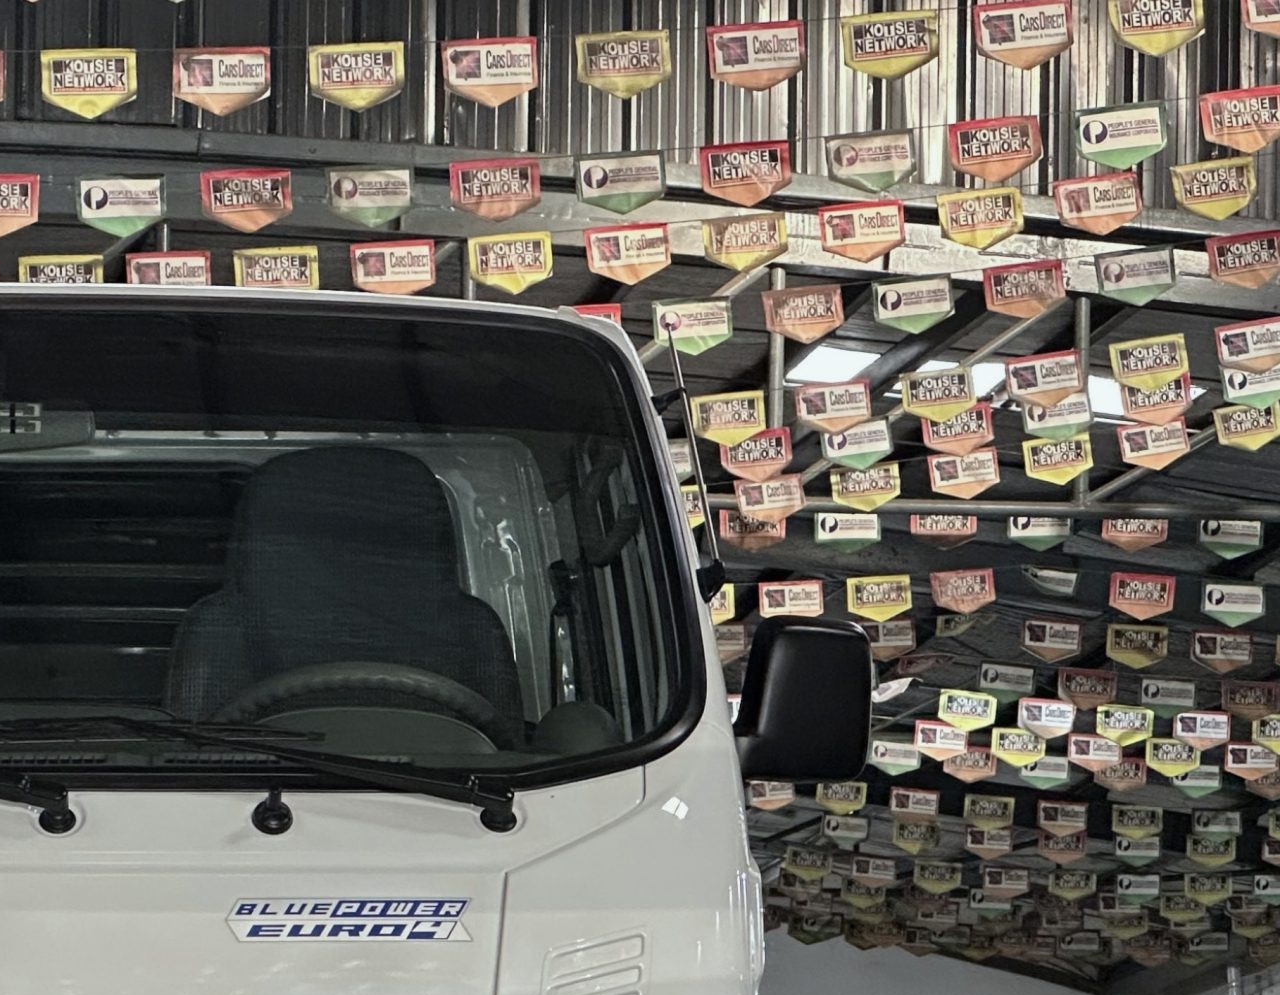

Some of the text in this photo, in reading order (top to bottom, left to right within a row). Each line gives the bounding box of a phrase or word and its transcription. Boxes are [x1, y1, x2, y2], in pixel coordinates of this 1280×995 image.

[1121, 7, 1192, 27] NETWORK
[864, 22, 915, 37] KOTSE
[598, 40, 649, 54] KOTSE
[855, 37, 926, 52] NETWORK
[63, 59, 114, 73] KOTSE
[332, 54, 383, 67] KOTSE
[589, 54, 660, 68] NETWORK
[53, 73, 124, 87] NETWORK
[322, 66, 393, 82] NETWORK
[1134, 119, 1158, 127] GENERAL
[1213, 110, 1279, 128] NETWORK
[970, 127, 1018, 141] KOTSE
[961, 140, 1030, 156] NETWORK
[721, 150, 769, 164] KOTSE
[472, 169, 518, 182] KOTSE
[1192, 167, 1235, 183] KOTSE
[222, 179, 271, 192] KOTSE
[463, 182, 529, 196] NETWORK
[1184, 181, 1246, 197] NETWORK
[214, 192, 281, 206] NETWORK
[959, 197, 1002, 212] KOTSE
[951, 209, 1012, 225] NETWORK
[489, 242, 533, 255] KOTSE
[1227, 240, 1267, 255] KOTSE
[254, 256, 298, 268] KOTSE
[481, 253, 542, 267] NETWORK
[1220, 252, 1277, 268] NETWORK
[39, 265, 83, 276] KOTSE
[246, 267, 308, 281] NETWORK
[1003, 271, 1045, 285] KOTSE
[995, 282, 1055, 298] NETWORK
[1129, 344, 1168, 358] KOTSE
[1122, 355, 1177, 371] NETWORK
[919, 375, 958, 389] KOTSE
[911, 386, 966, 400] NETWORK
